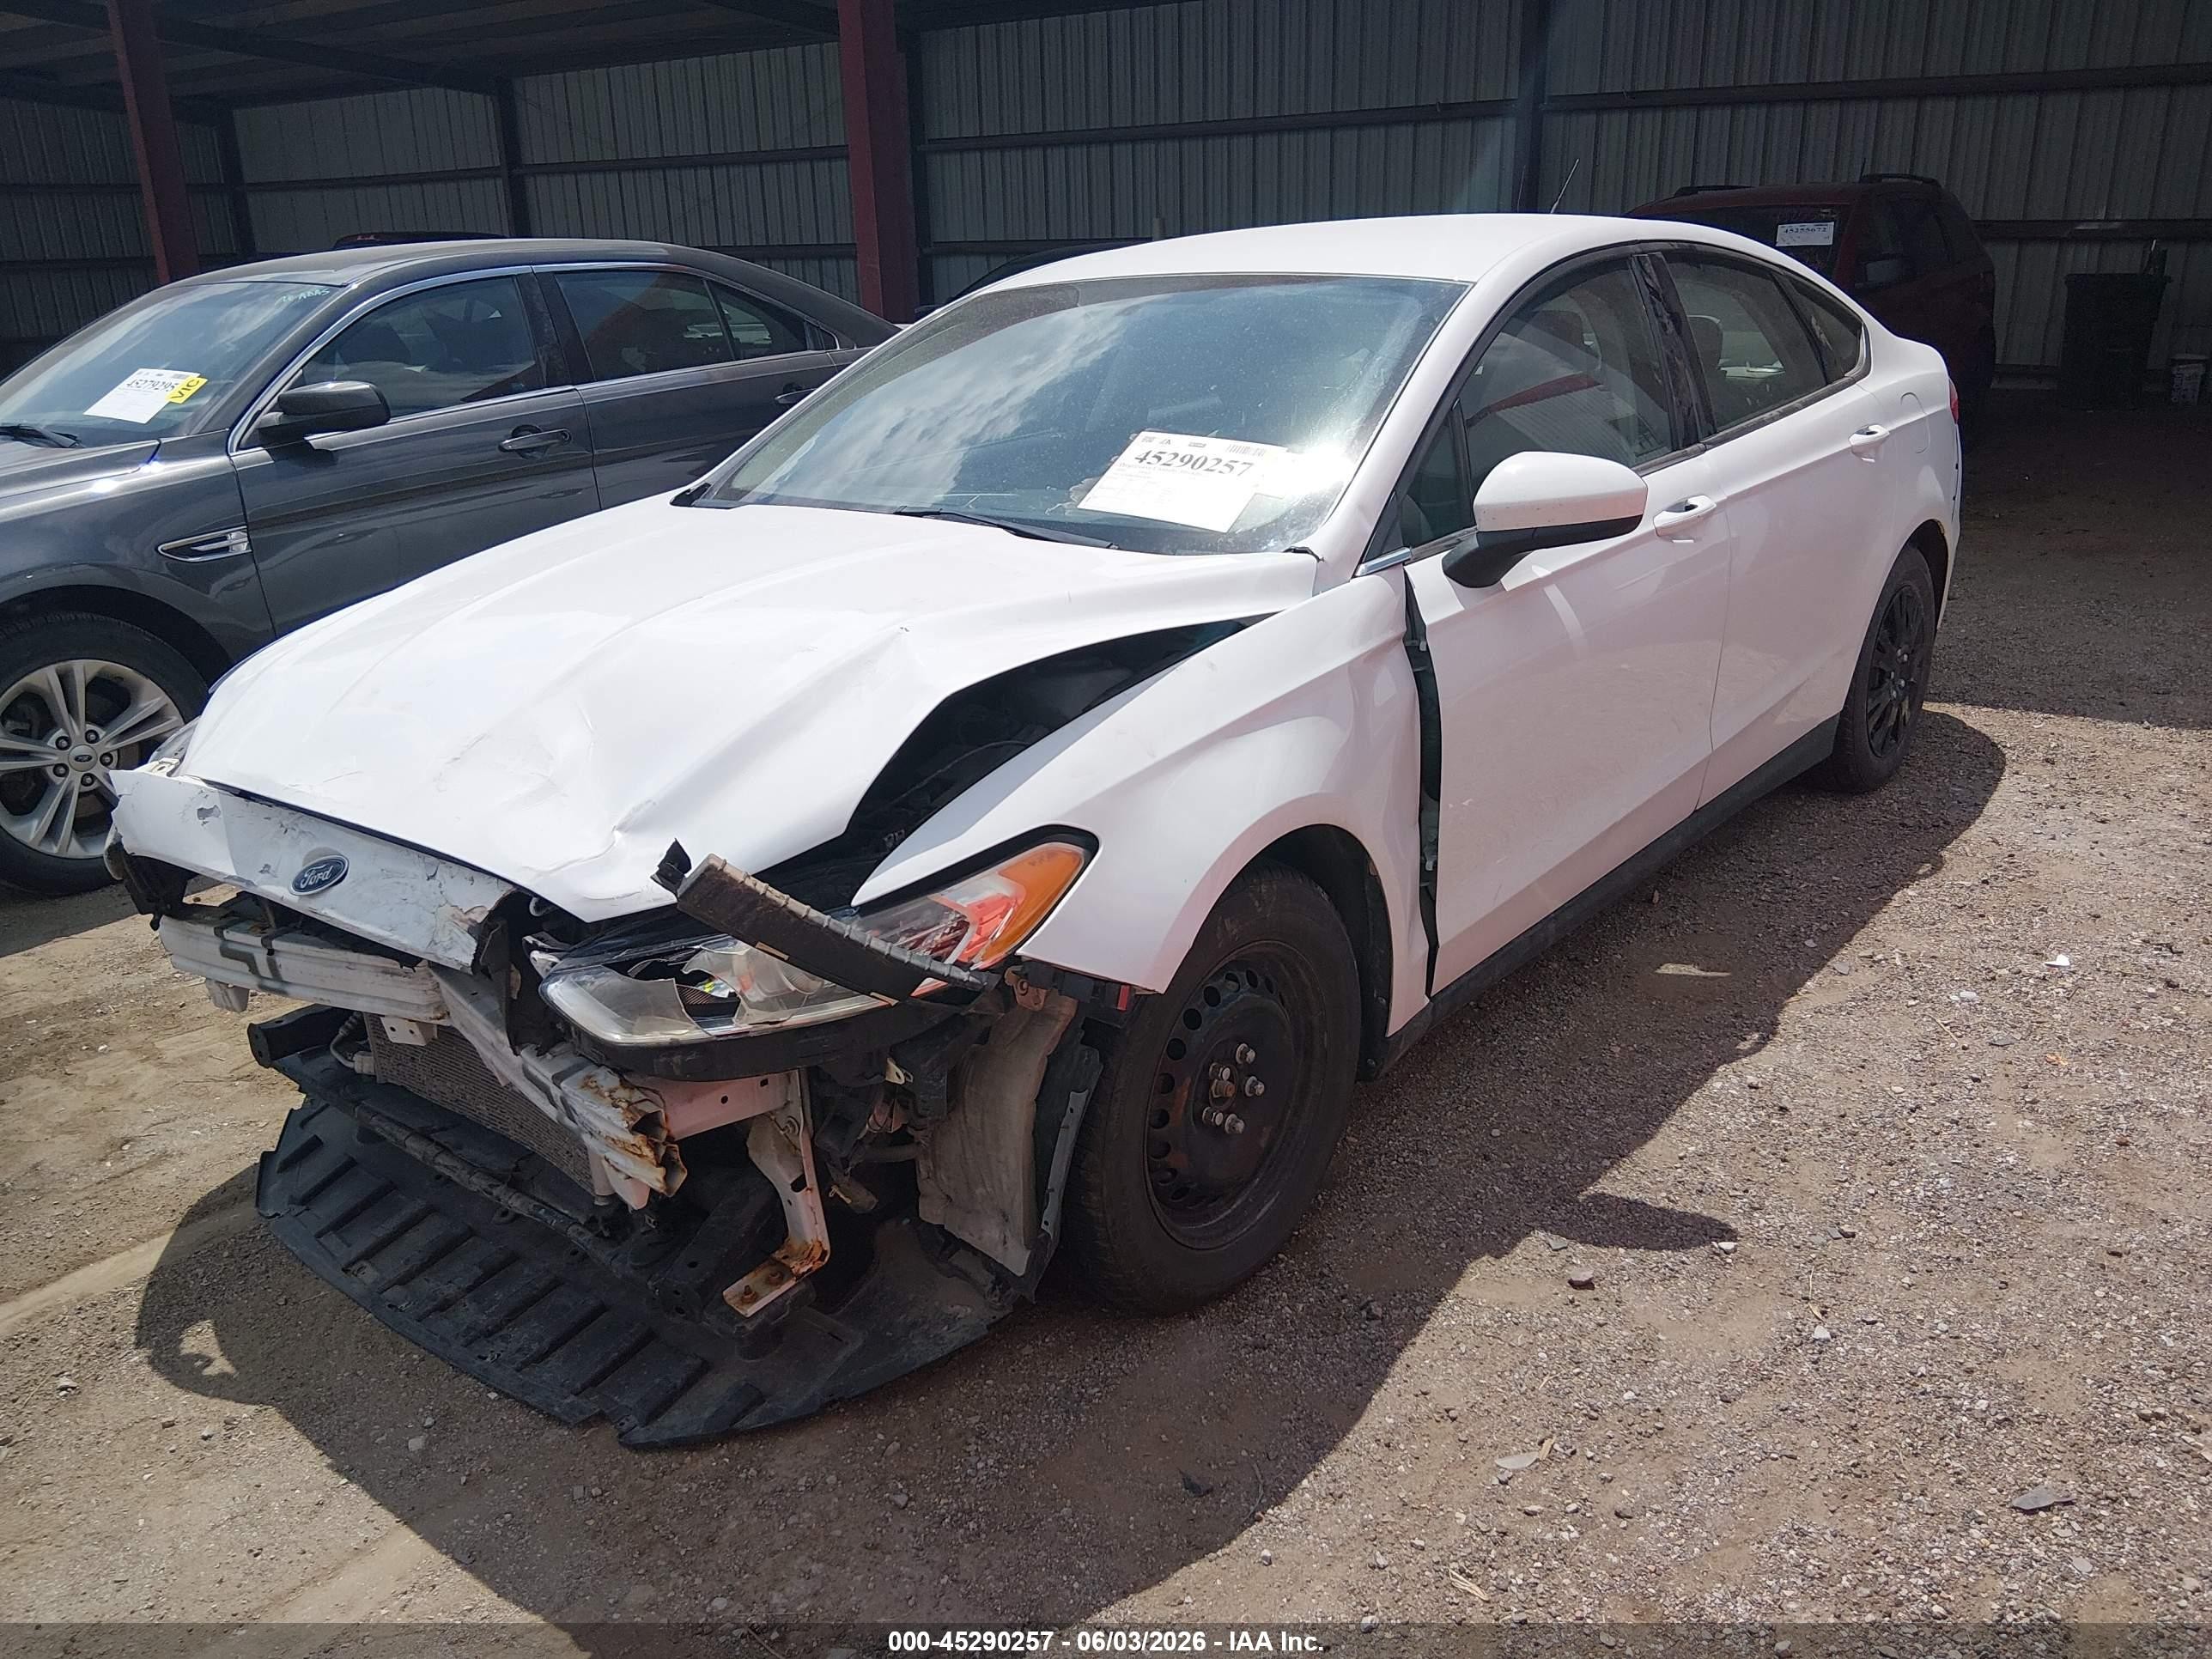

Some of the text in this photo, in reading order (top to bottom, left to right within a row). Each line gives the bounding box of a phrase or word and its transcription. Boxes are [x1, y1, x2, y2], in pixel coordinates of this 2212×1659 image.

[170, 379, 200, 399] VIC
[1133, 449, 1255, 477] 45290257
[300, 864, 334, 889] Ford
